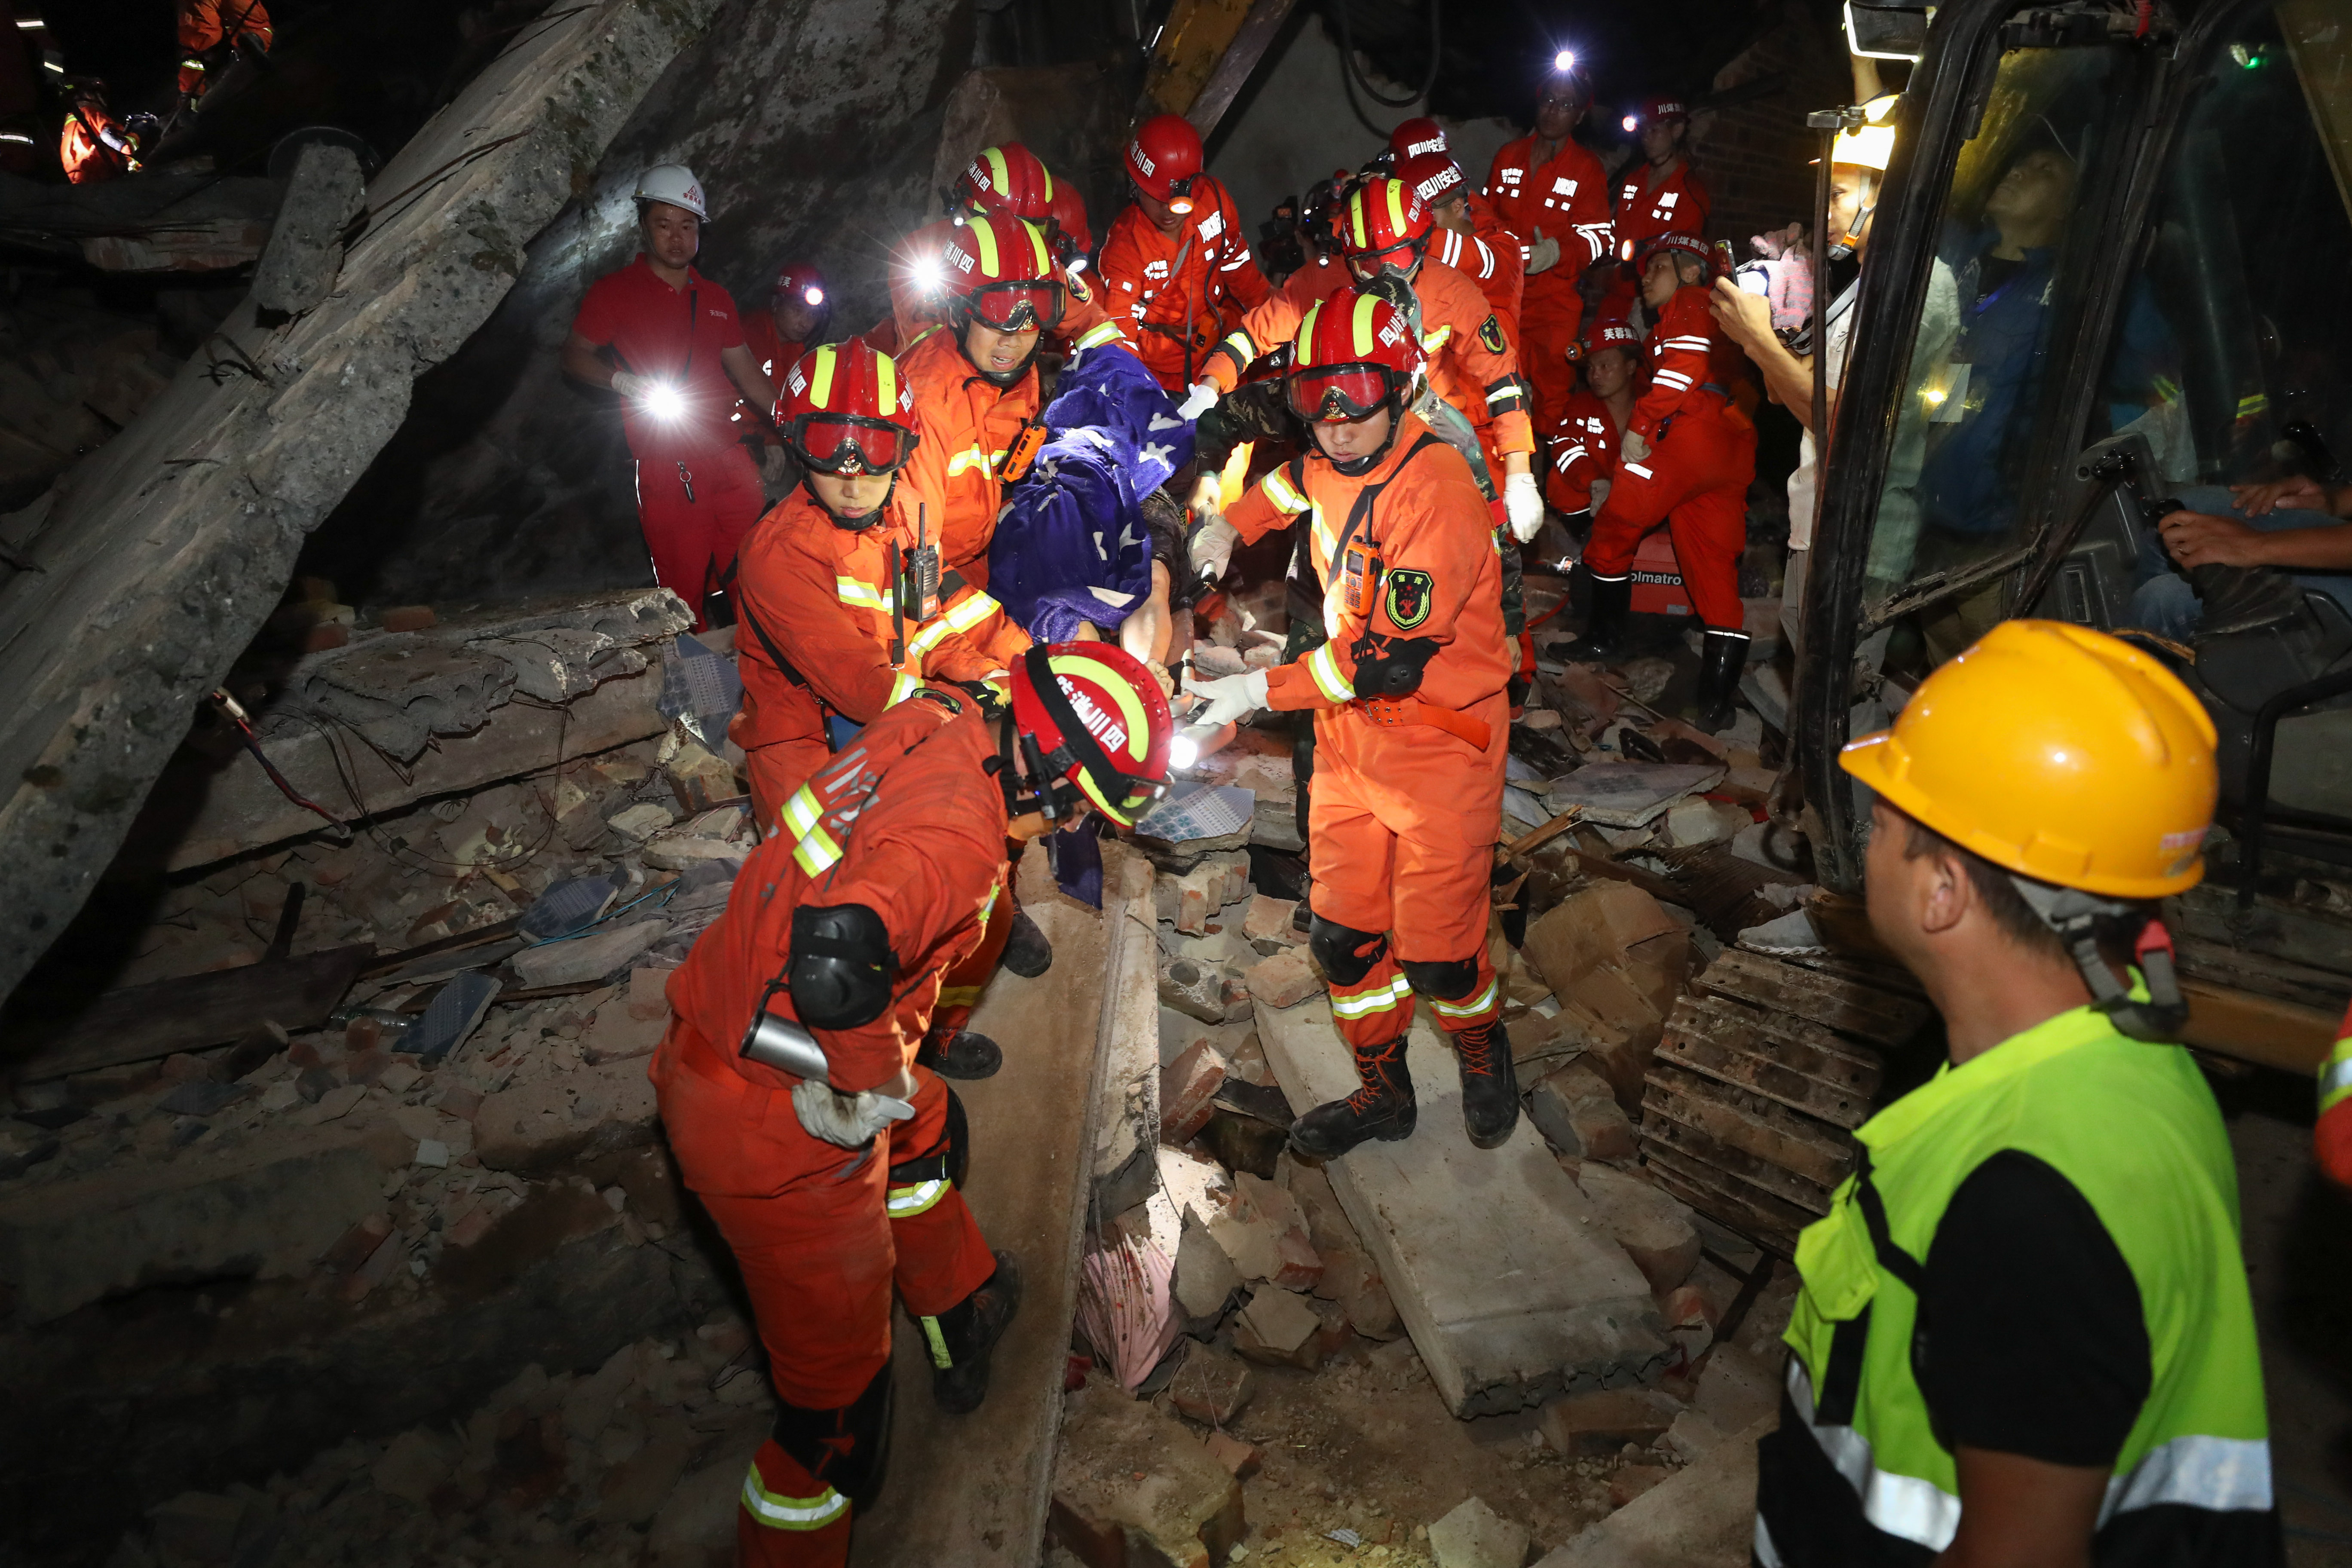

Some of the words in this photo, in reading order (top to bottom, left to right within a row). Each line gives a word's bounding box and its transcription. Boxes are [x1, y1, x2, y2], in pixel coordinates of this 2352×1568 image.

[1408, 136, 1447, 159] 四川安监
[1416, 166, 1462, 201] 四川安监
[1666, 236, 1709, 255] 川煤集团
[1397, 574, 1423, 585] 指挥
